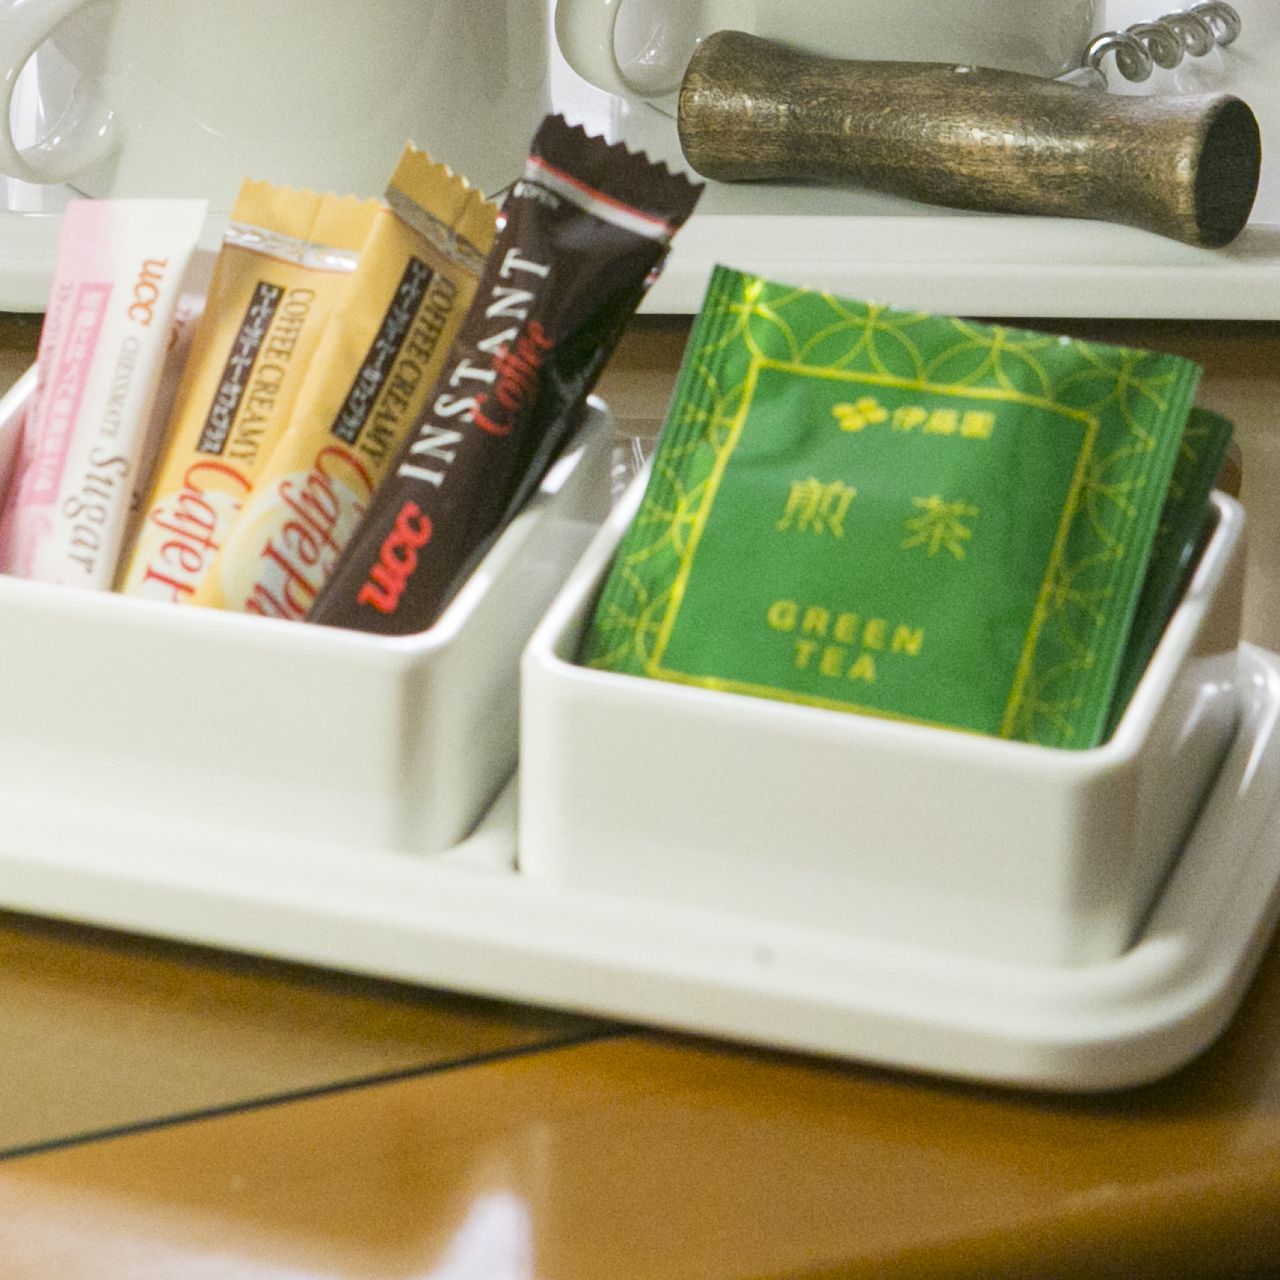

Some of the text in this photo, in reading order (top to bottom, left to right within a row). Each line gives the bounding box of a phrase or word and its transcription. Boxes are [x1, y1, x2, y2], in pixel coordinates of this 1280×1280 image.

[228, 287, 316, 467] COFFEE CREAMY
[397, 247, 552, 488] INSTANT
[470, 320, 555, 436] Coffee
[62, 445, 130, 575] Sugar
[774, 475, 982, 560] 煎茶
[766, 599, 926, 657] GREEN
[793, 638, 879, 685] TEA
